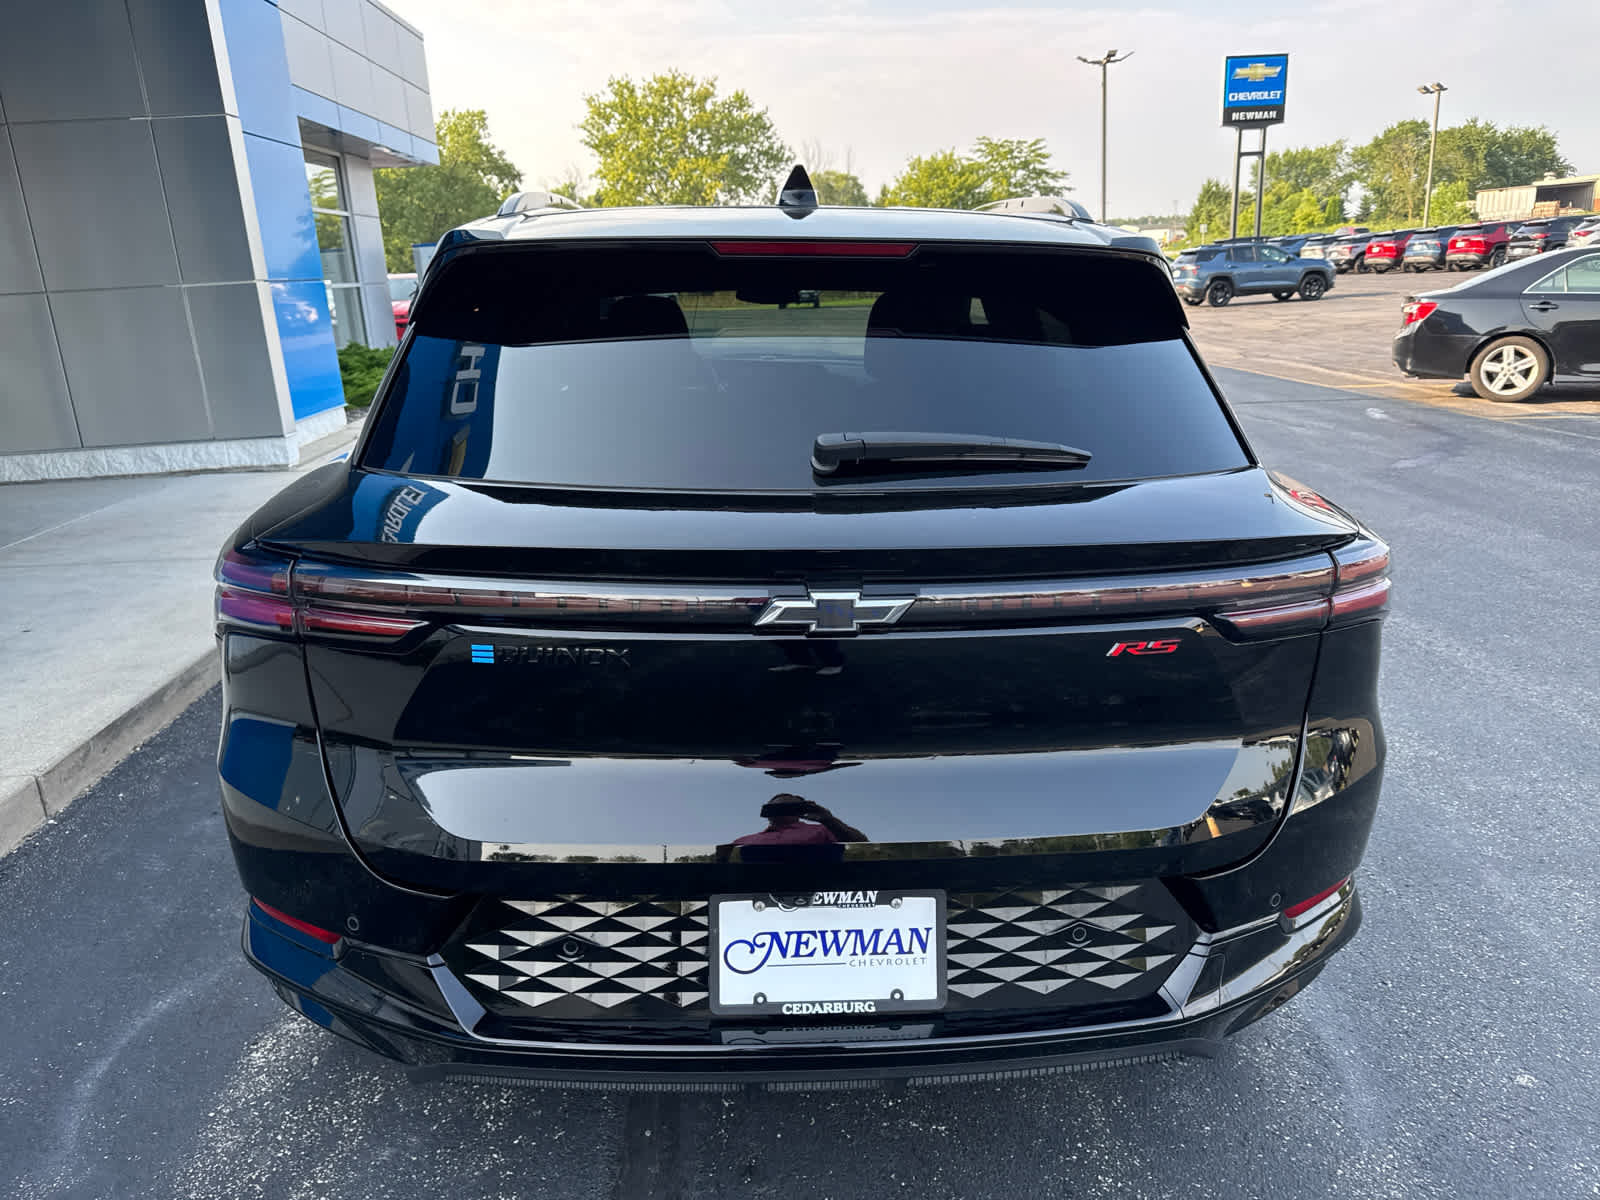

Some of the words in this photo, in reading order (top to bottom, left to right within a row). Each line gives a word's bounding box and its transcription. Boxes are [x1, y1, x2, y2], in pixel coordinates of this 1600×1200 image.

[1228, 90, 1282, 102] CHEVROLET
[1231, 110, 1277, 121] NEWMAN
[1105, 638, 1182, 657] RS
[723, 927, 933, 975] NEWMAN
[848, 957, 928, 968] CHEVROLET
[782, 1001, 876, 1015] CEDARBURG
